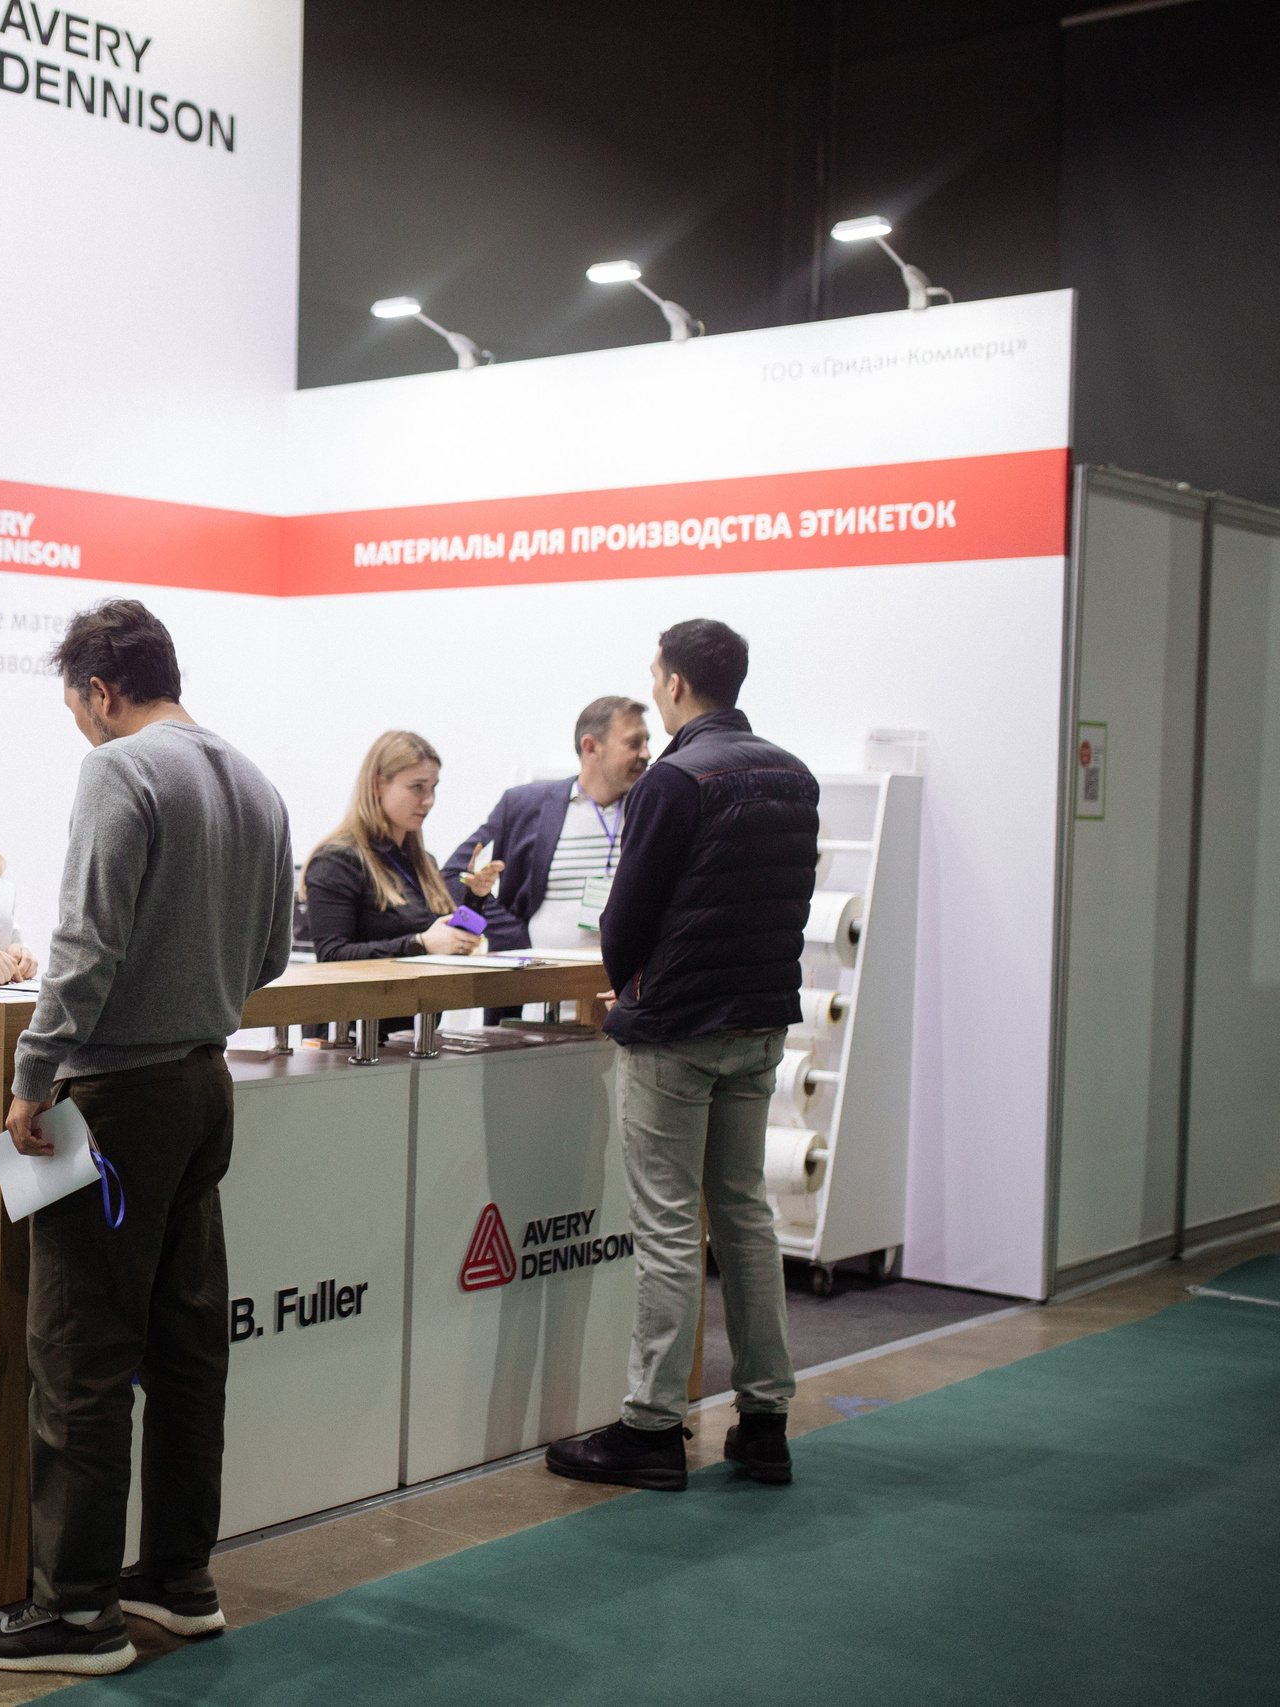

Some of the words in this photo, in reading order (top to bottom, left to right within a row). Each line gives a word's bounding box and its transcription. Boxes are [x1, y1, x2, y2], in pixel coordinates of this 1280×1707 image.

[0, 0, 152, 73] AVERY
[0, 49, 234, 152] DENNISON
[760, 362, 803, 383] ТОО
[354, 532, 505, 567] МАТЕРИАЛЫ
[509, 529, 565, 562] ДЛЯ
[571, 512, 793, 552] ПРОИЗВОДСТВА
[799, 500, 957, 537] ЭТИКЕТОК
[521, 1232, 634, 1281] DENNISON
[523, 1209, 596, 1248] AVERY
[229, 1297, 264, 1343] B.
[276, 1278, 368, 1333] Fuller
